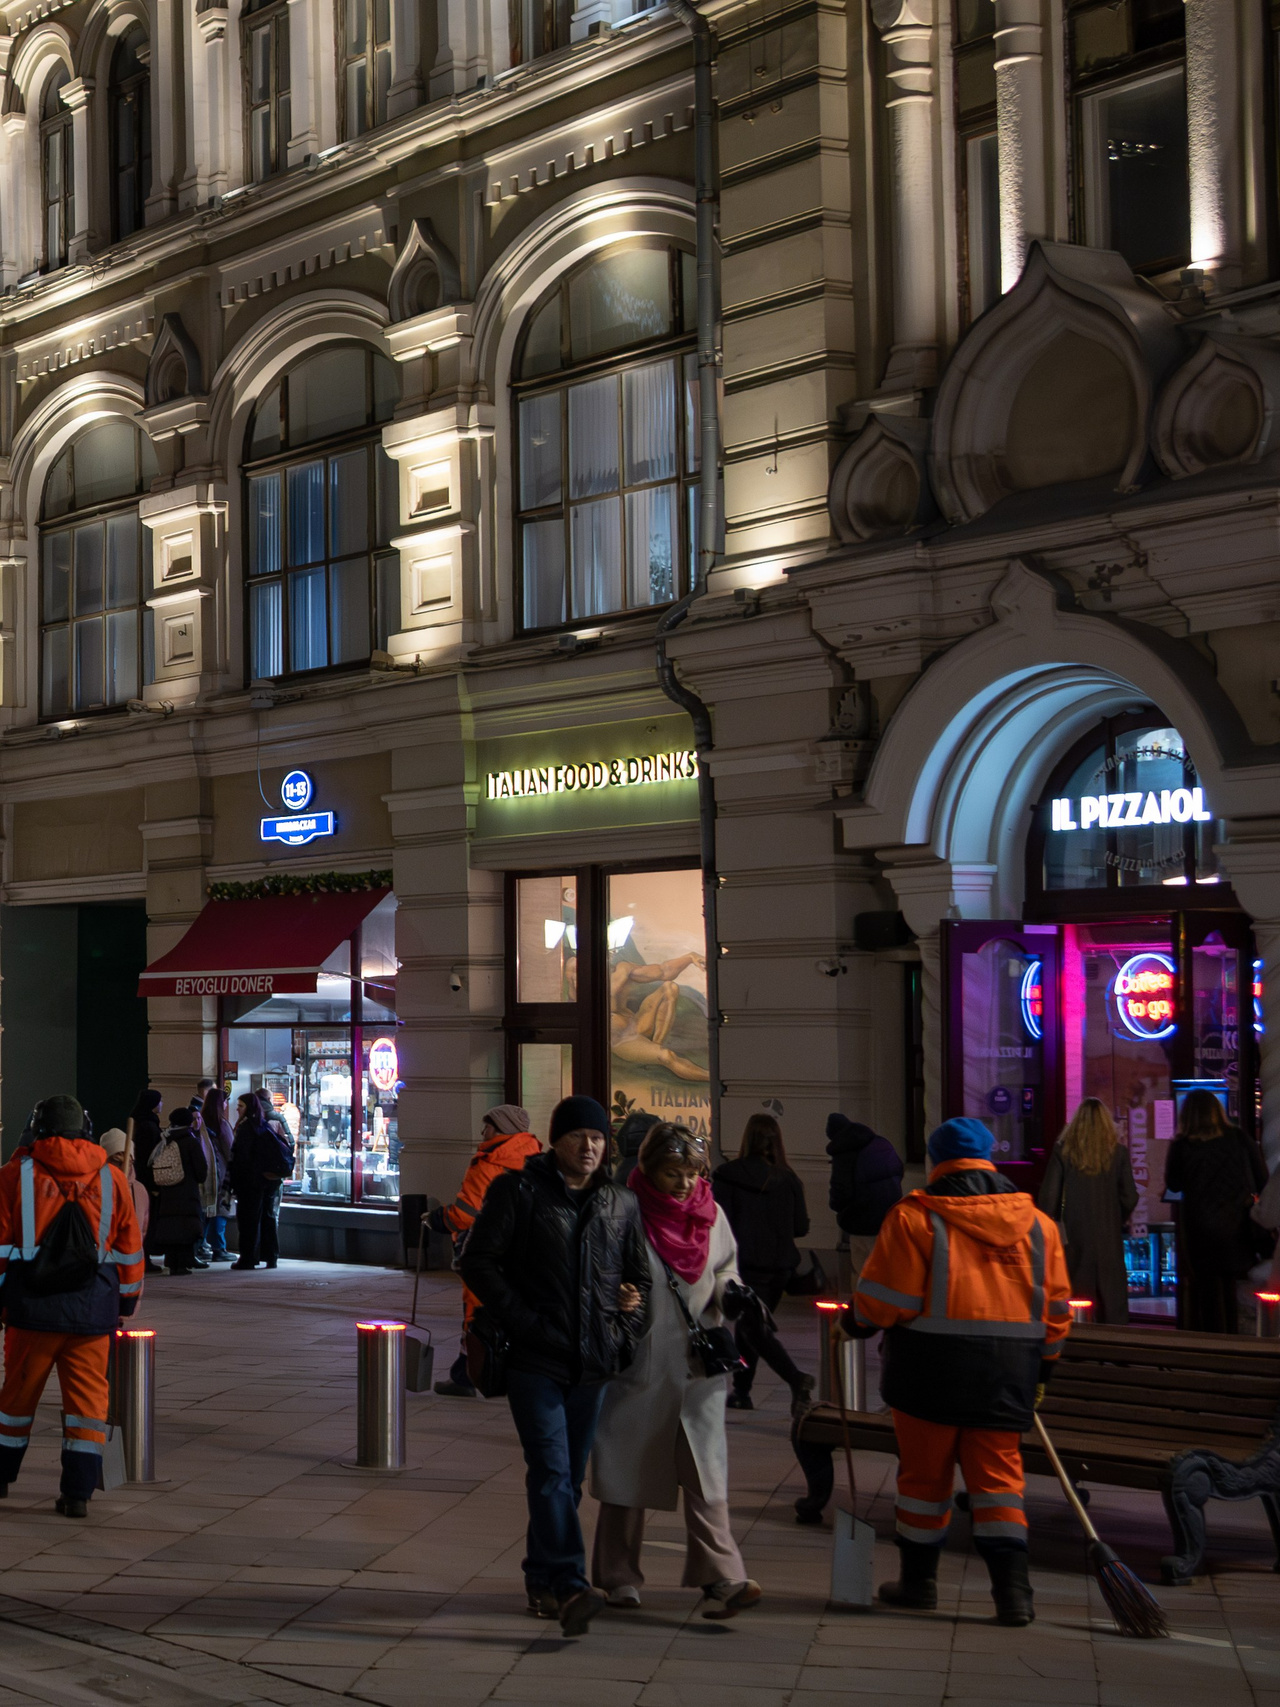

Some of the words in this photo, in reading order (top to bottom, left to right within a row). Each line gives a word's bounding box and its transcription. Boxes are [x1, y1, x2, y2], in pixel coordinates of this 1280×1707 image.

[486, 767, 549, 799] ITALIAN
[554, 760, 609, 792] FOOD
[609, 758, 628, 787] &
[627, 751, 699, 784] DRINKS
[1051, 798, 1077, 831] IL
[175, 977, 230, 995] BEYOGLU
[231, 976, 273, 994] DONER
[1120, 971, 1172, 994] Coffee
[1127, 999, 1146, 1017] to
[1148, 1000, 1172, 1020] go
[650, 1086, 710, 1107] ITALIAN
[689, 1115, 710, 1137] PA
